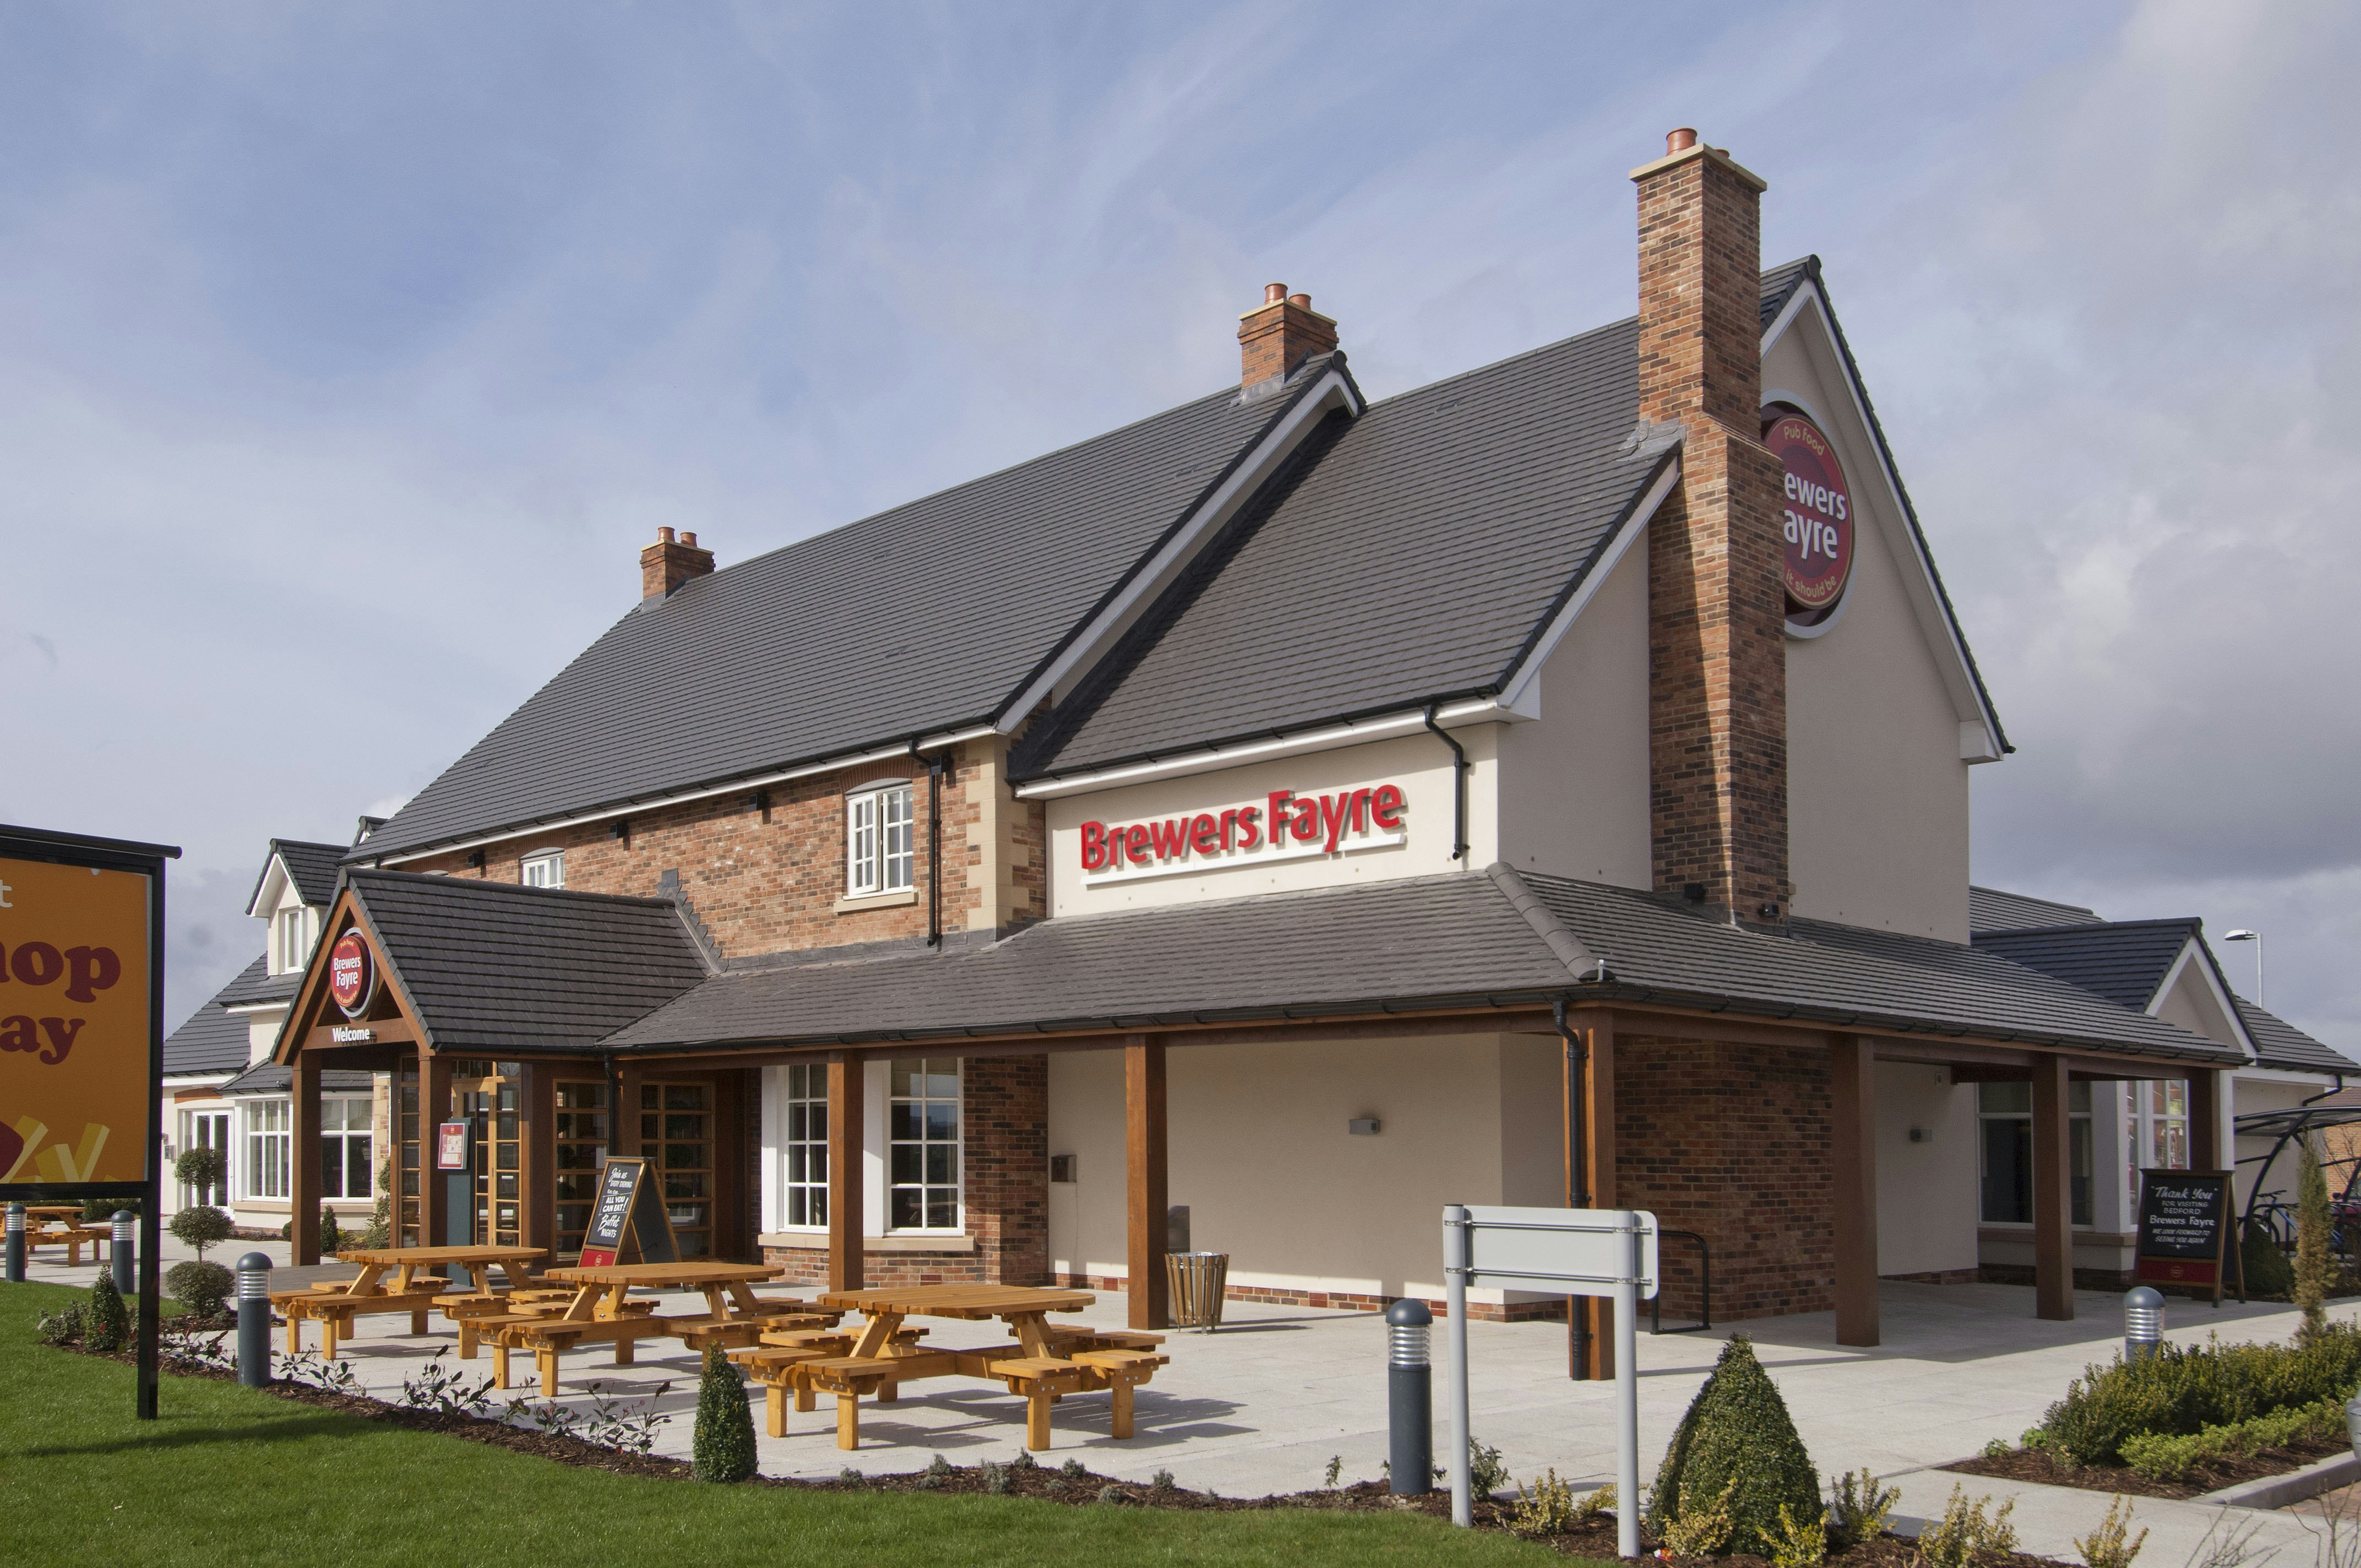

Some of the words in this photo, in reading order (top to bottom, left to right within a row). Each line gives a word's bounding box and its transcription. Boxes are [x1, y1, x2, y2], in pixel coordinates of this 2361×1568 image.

[1784, 424, 1801, 440] Pub
[1802, 428, 1825, 456] food
[1785, 472, 1846, 520] ewers
[1784, 509, 1837, 560] ayre
[1786, 569, 1794, 585] it
[1795, 580, 1825, 598] should
[1824, 576, 1836, 591] be
[1081, 807, 1262, 869] Brewers
[1269, 785, 1408, 853] Fayre
[0, 941, 121, 1003] op
[334, 957, 361, 971] Brewers
[336, 971, 358, 990] Fayre
[332, 1026, 370, 1042] Welcome
[608, 1167, 622, 1183] Join
[597, 1213, 620, 1232] Buffet
[2149, 1215, 2186, 1224] Brewers
[2189, 1216, 2216, 1227] Fayre
[600, 1229, 617, 1238] NIGHTS
